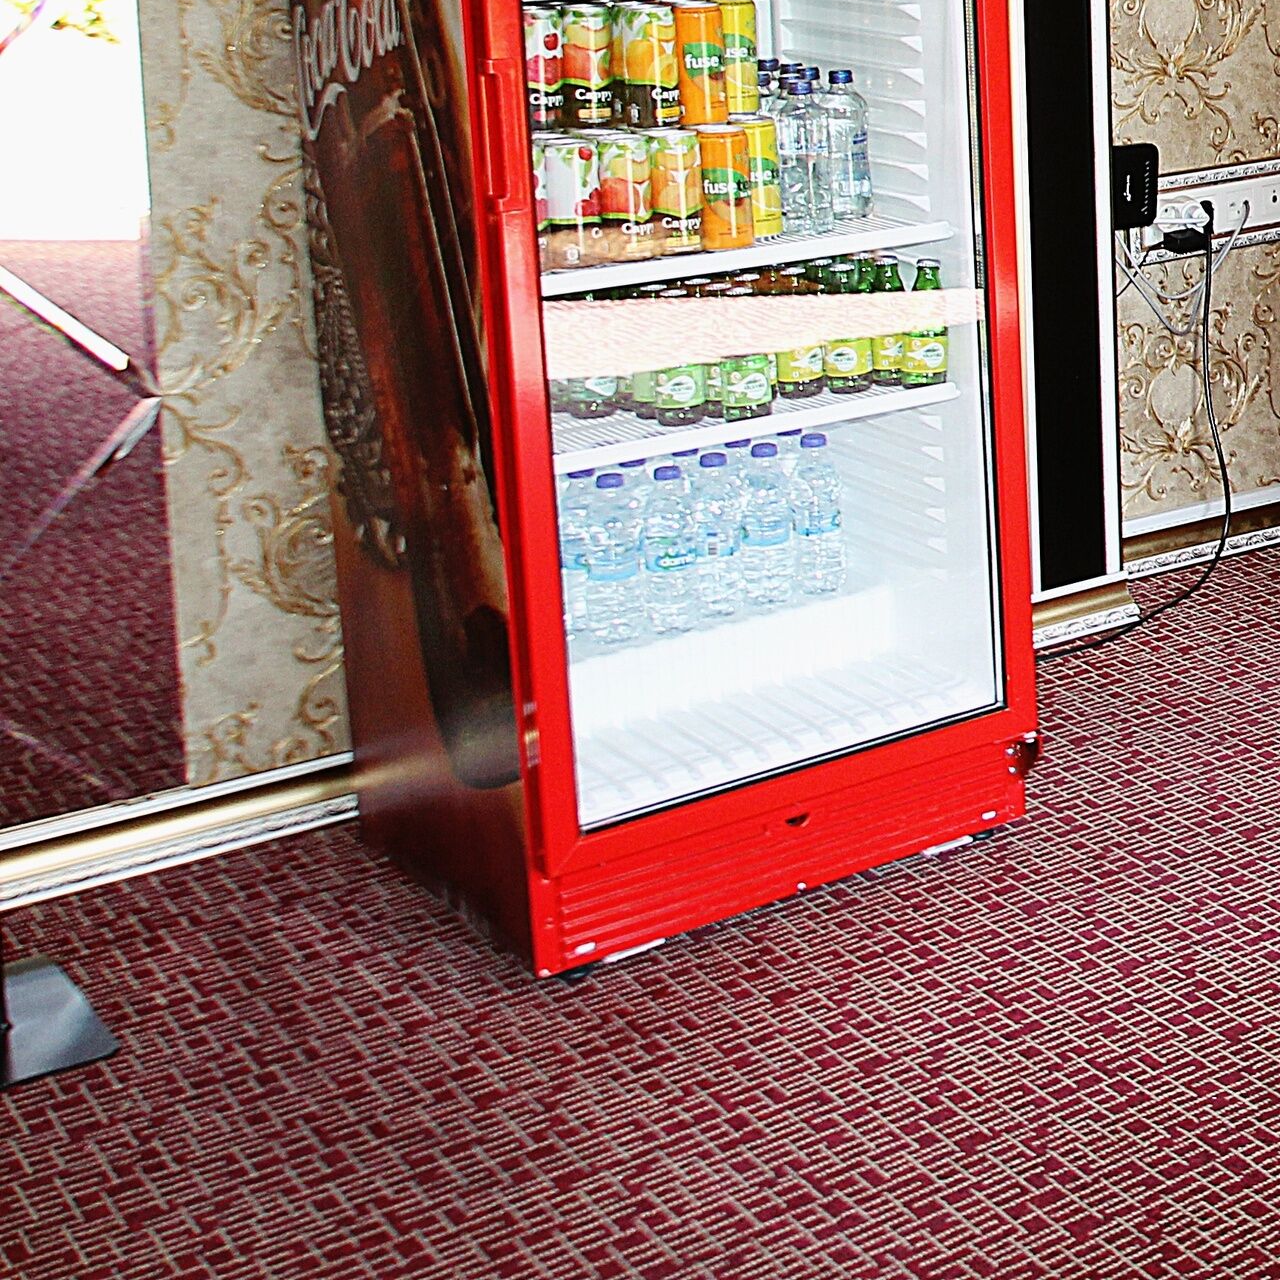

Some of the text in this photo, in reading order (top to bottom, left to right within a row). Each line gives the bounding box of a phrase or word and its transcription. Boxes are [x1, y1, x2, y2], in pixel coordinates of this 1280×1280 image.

[574, 88, 613, 102] Cappy
[651, 88, 680, 101] Capp
[621, 222, 654, 236] Capp
[661, 216, 701, 232] Cappy
